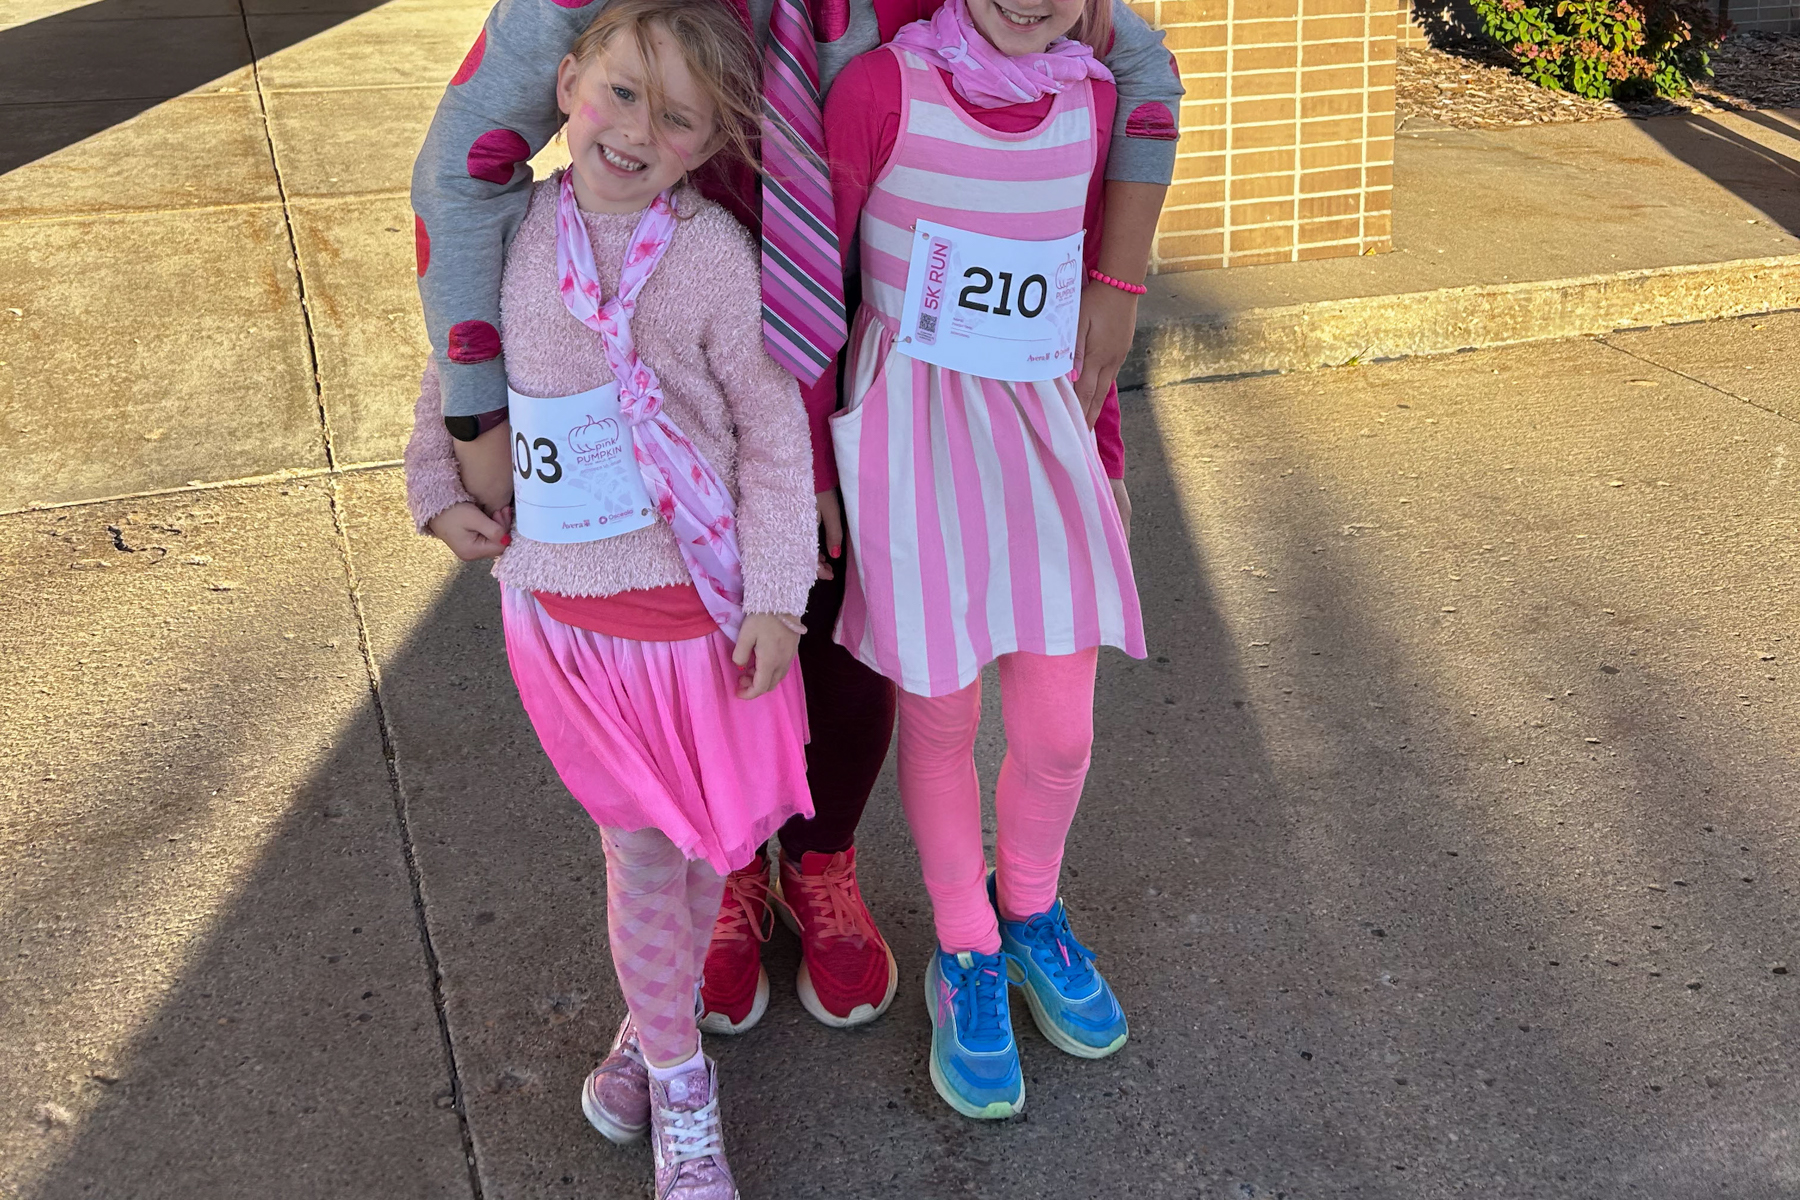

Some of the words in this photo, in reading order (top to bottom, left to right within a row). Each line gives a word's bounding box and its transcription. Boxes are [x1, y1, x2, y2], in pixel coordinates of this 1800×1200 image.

[929, 242, 949, 284] RUN
[924, 287, 941, 310] 5K
[957, 266, 1048, 319] 210
[510, 424, 563, 484] 03
[576, 445, 623, 465] PUMPKIN
[595, 437, 617, 452] pink
[561, 520, 584, 530] Avera
[608, 509, 634, 521] Osceola
